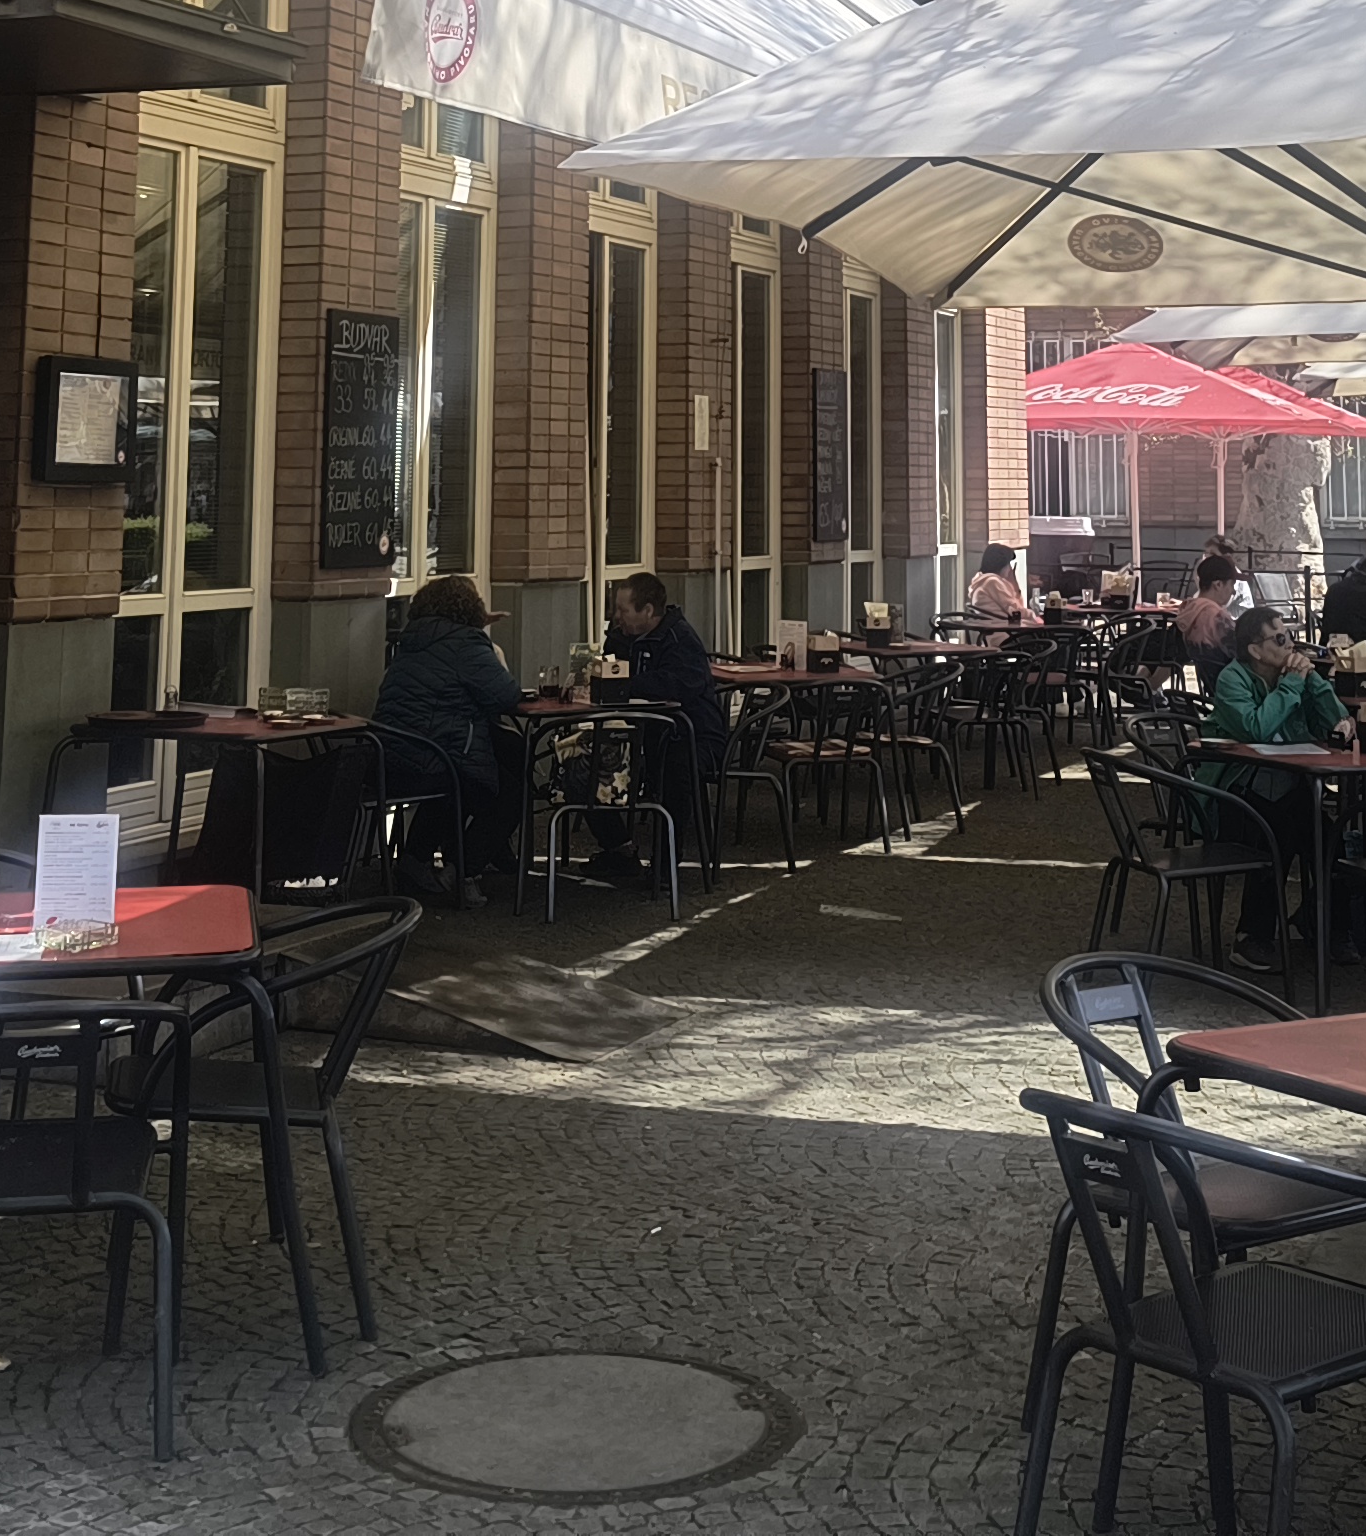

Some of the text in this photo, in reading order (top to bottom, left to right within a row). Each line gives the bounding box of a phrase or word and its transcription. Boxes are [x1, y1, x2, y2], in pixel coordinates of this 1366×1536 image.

[333, 319, 392, 353] BUDVAR
[333, 384, 353, 413] 33
[328, 454, 356, 480] ČERNÉ
[325, 521, 362, 548] RADLER
